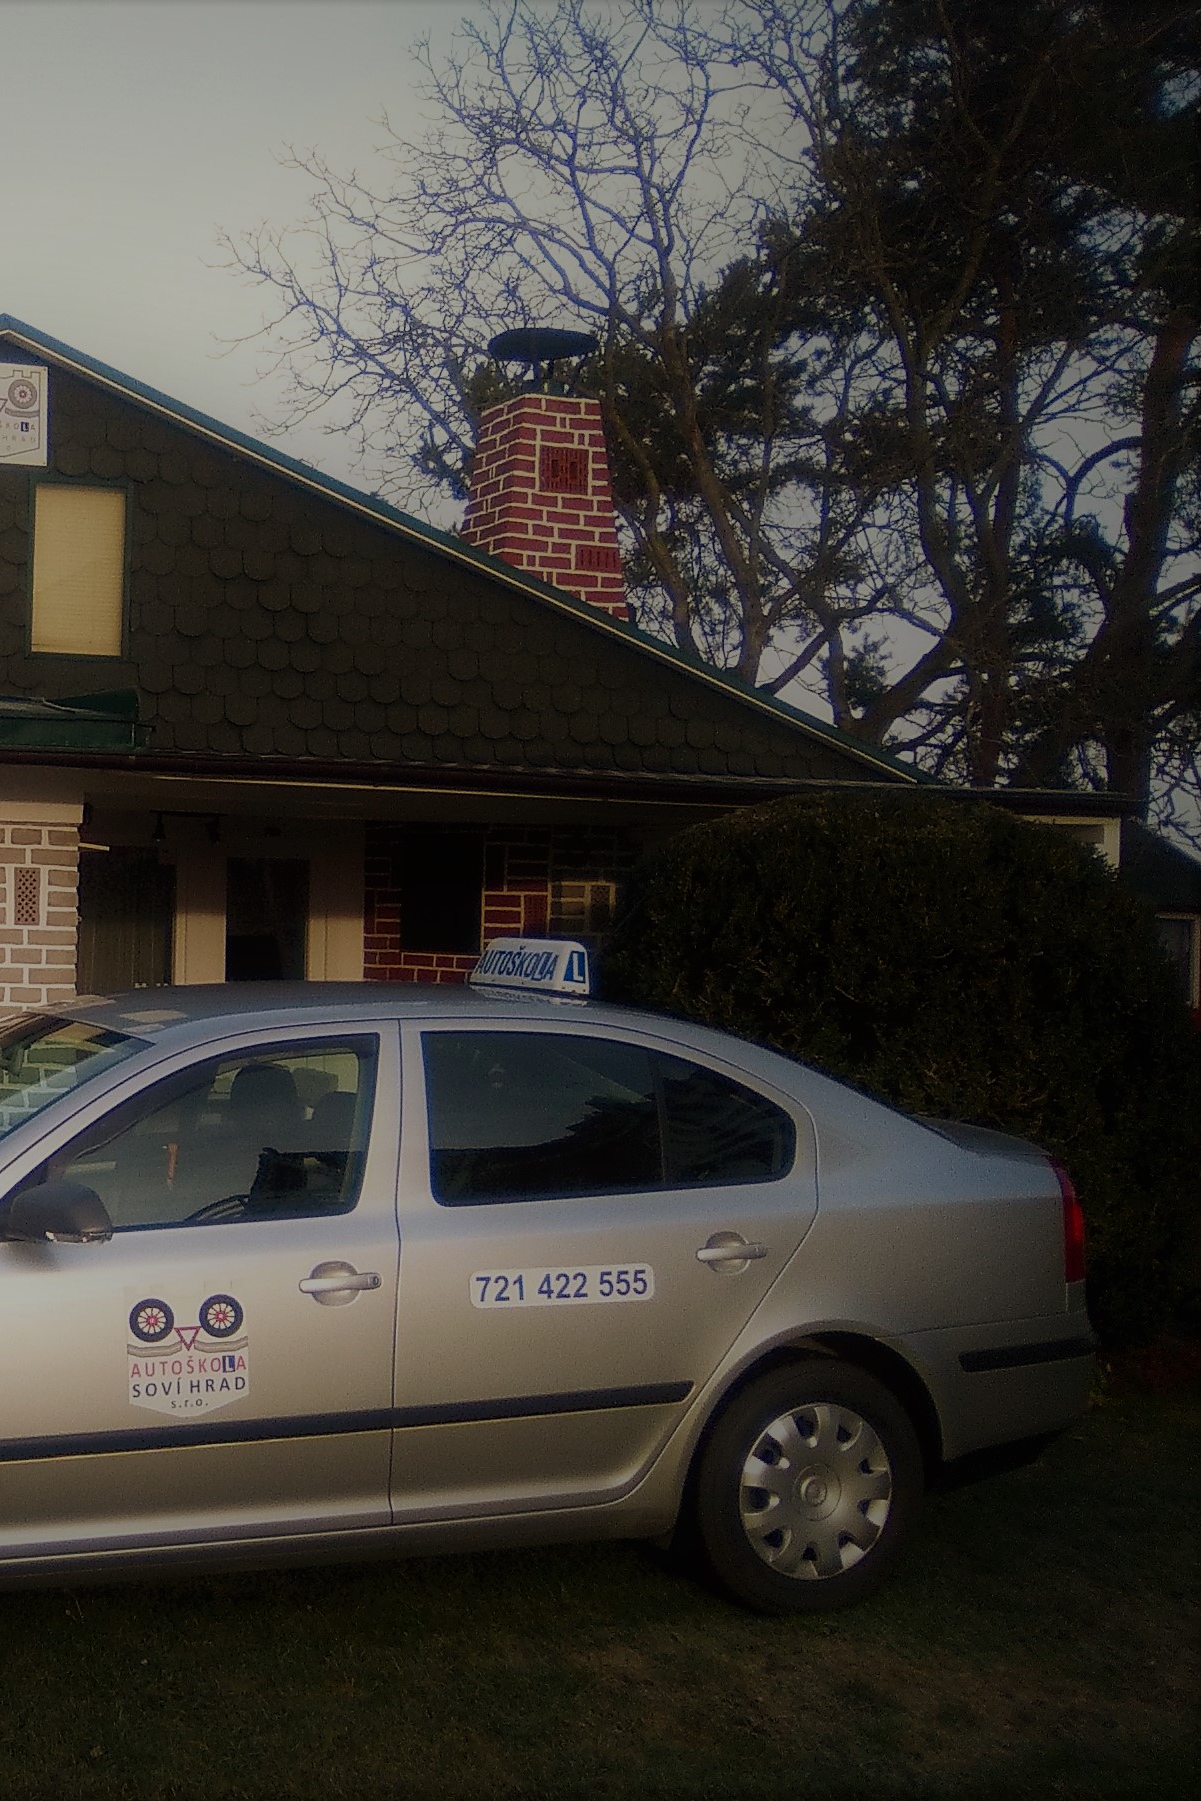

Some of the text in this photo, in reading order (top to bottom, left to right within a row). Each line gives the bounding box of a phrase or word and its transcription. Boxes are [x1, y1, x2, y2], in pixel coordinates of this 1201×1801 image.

[475, 946, 584, 982] AUTOŠKOLA L
[475, 1269, 648, 1302] 721 422 555
[131, 1355, 246, 1378] AUTOŠKOLA
[132, 1376, 246, 1398] SOVÍ HRAD
